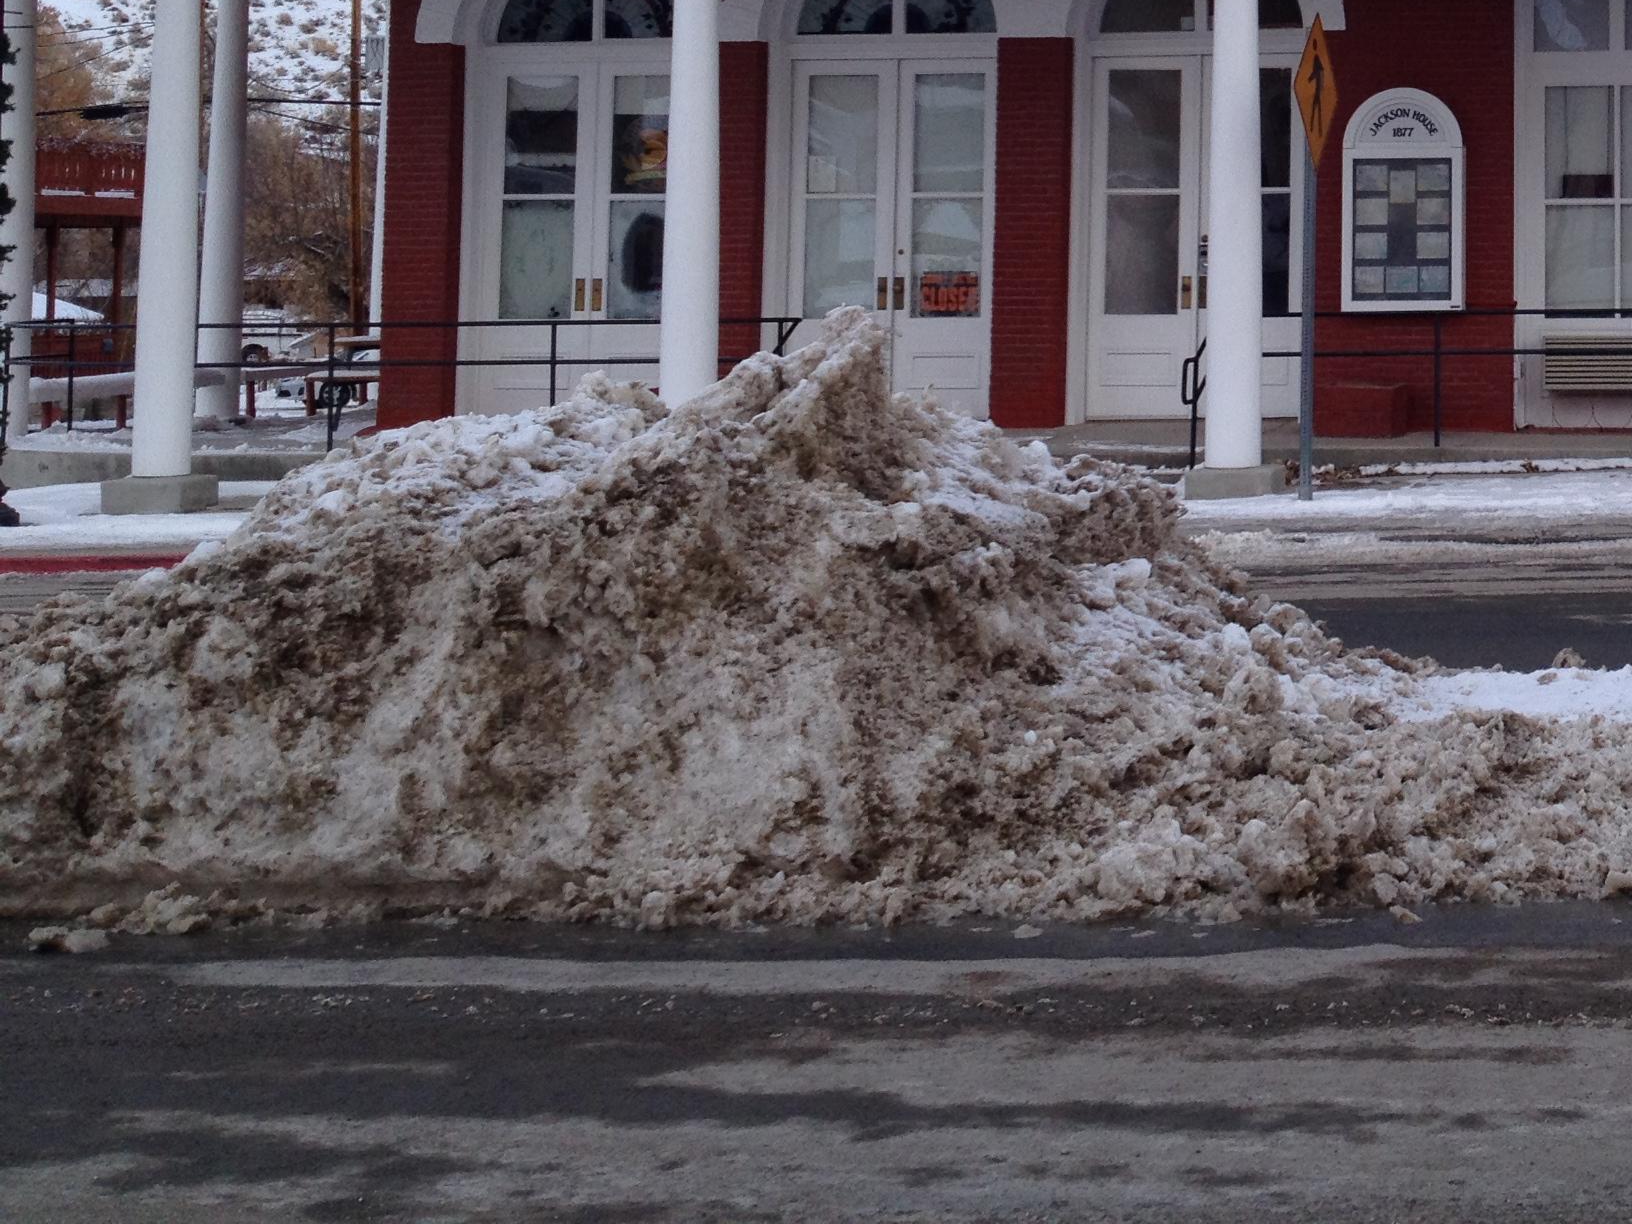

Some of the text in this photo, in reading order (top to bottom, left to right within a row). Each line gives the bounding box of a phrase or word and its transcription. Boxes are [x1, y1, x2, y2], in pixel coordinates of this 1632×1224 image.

[1370, 107, 1439, 137] JACKSON HOUSE
[1392, 127, 1414, 138] 1877
